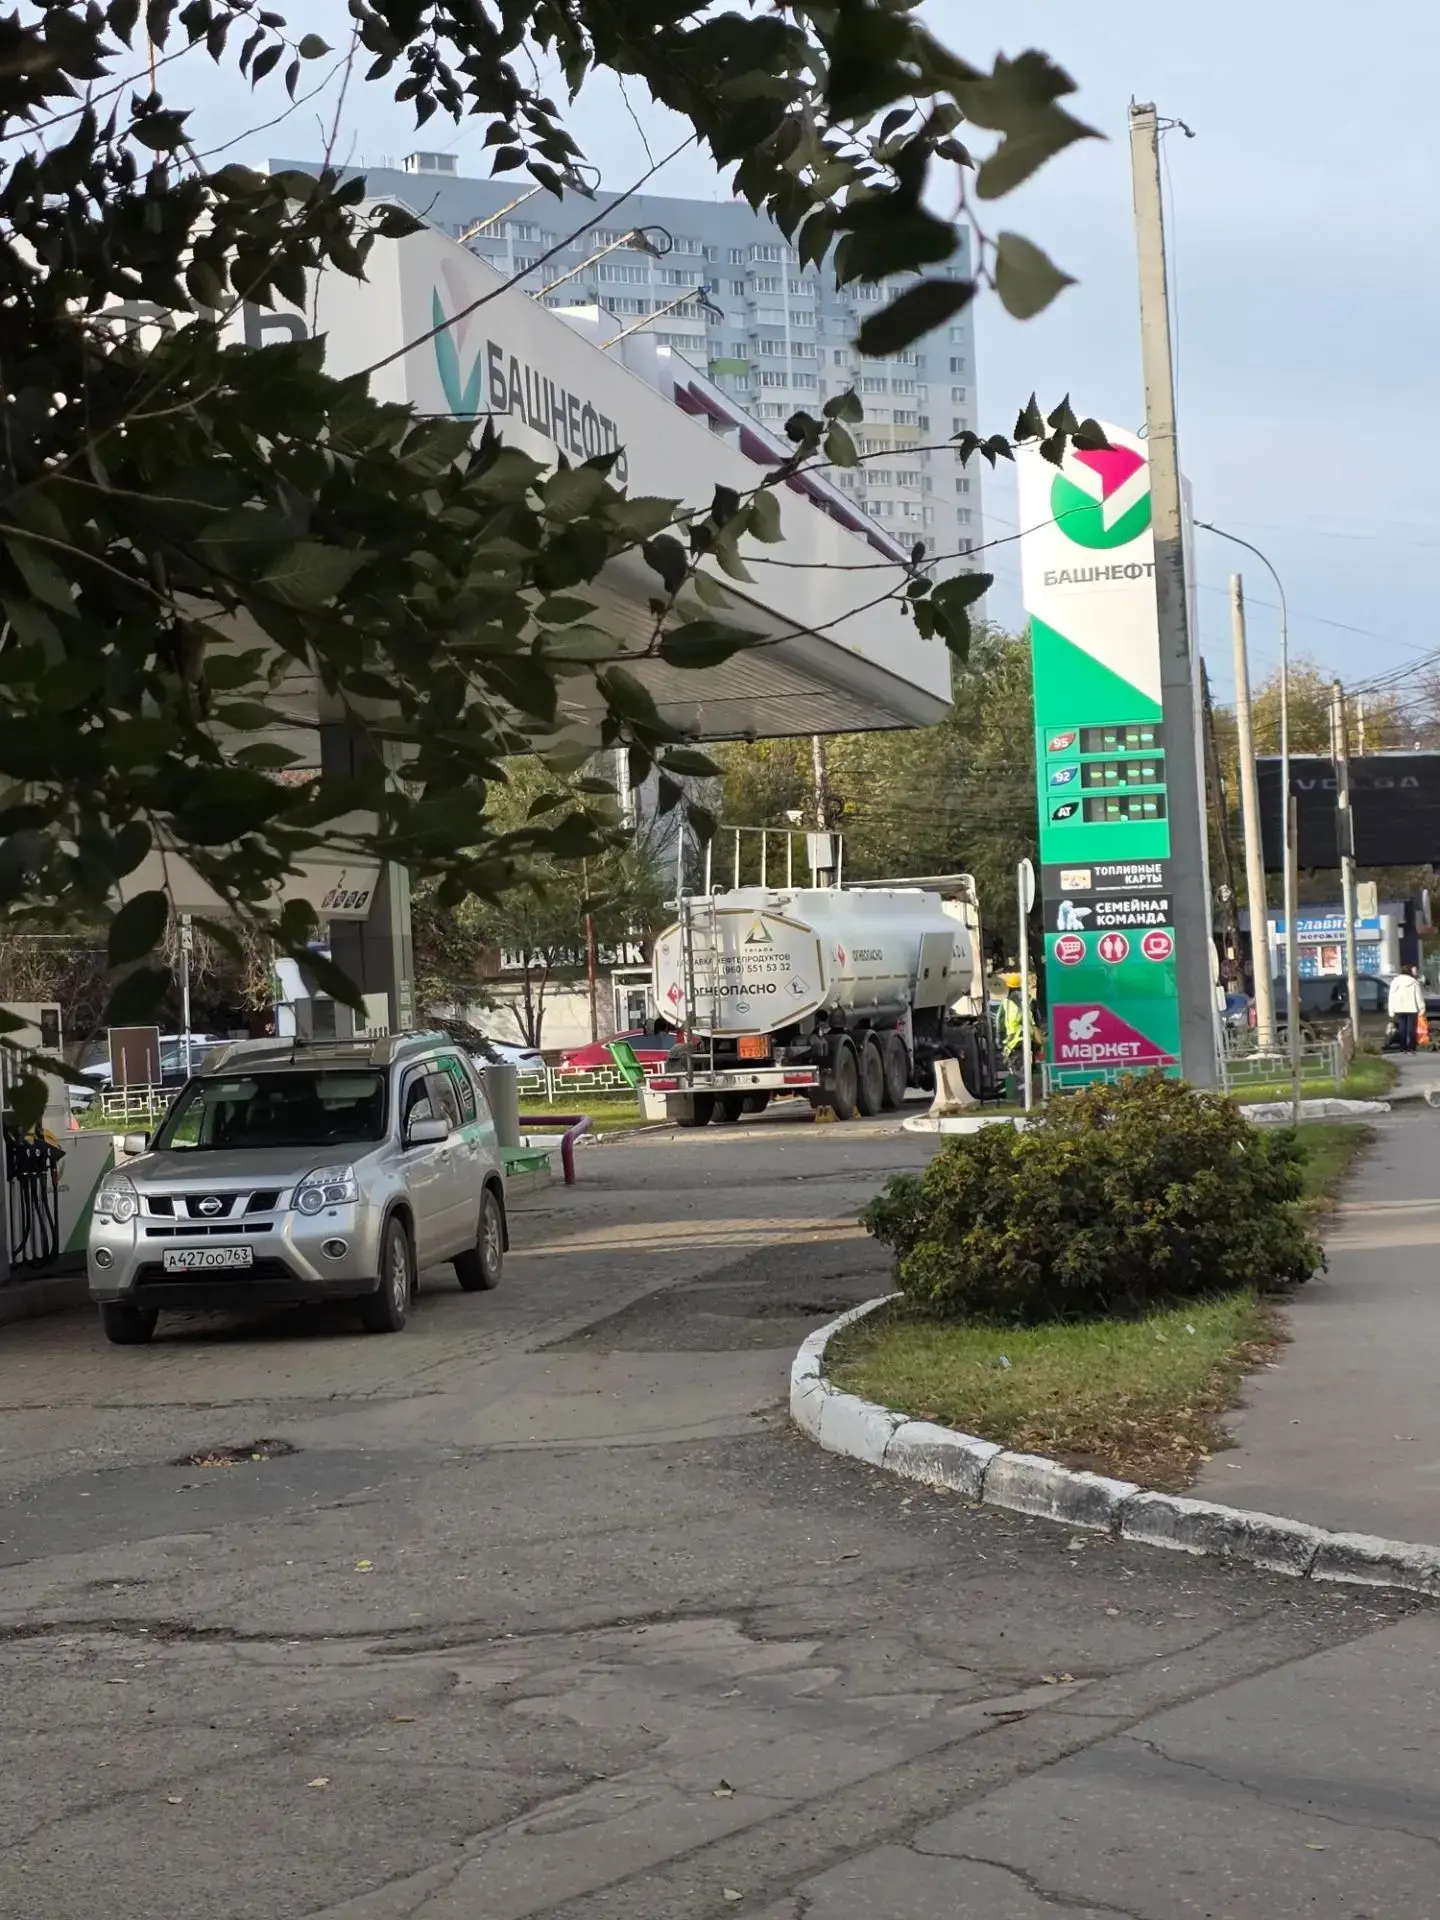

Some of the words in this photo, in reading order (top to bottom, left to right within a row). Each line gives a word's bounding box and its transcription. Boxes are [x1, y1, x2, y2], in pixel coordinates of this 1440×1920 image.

[487, 339, 628, 483] БАШНЕФТЬ
[1044, 562, 1156, 586] БАШНЕФТ
[1054, 737, 1069, 748] 95
[1055, 772, 1071, 782] 92
[1095, 864, 1162, 876] ТОПЛИВНЫЕ
[1125, 874, 1162, 884] КАРТЫ
[1095, 899, 1169, 913] СЕМЕЙНАЯ
[1096, 912, 1167, 926] КОМАНДА
[747, 964, 763, 973] 551
[766, 963, 777, 972] 53
[780, 963, 791, 971] 32
[1062, 1042, 1141, 1062] маркет
[225, 1248, 248, 1261] 763
